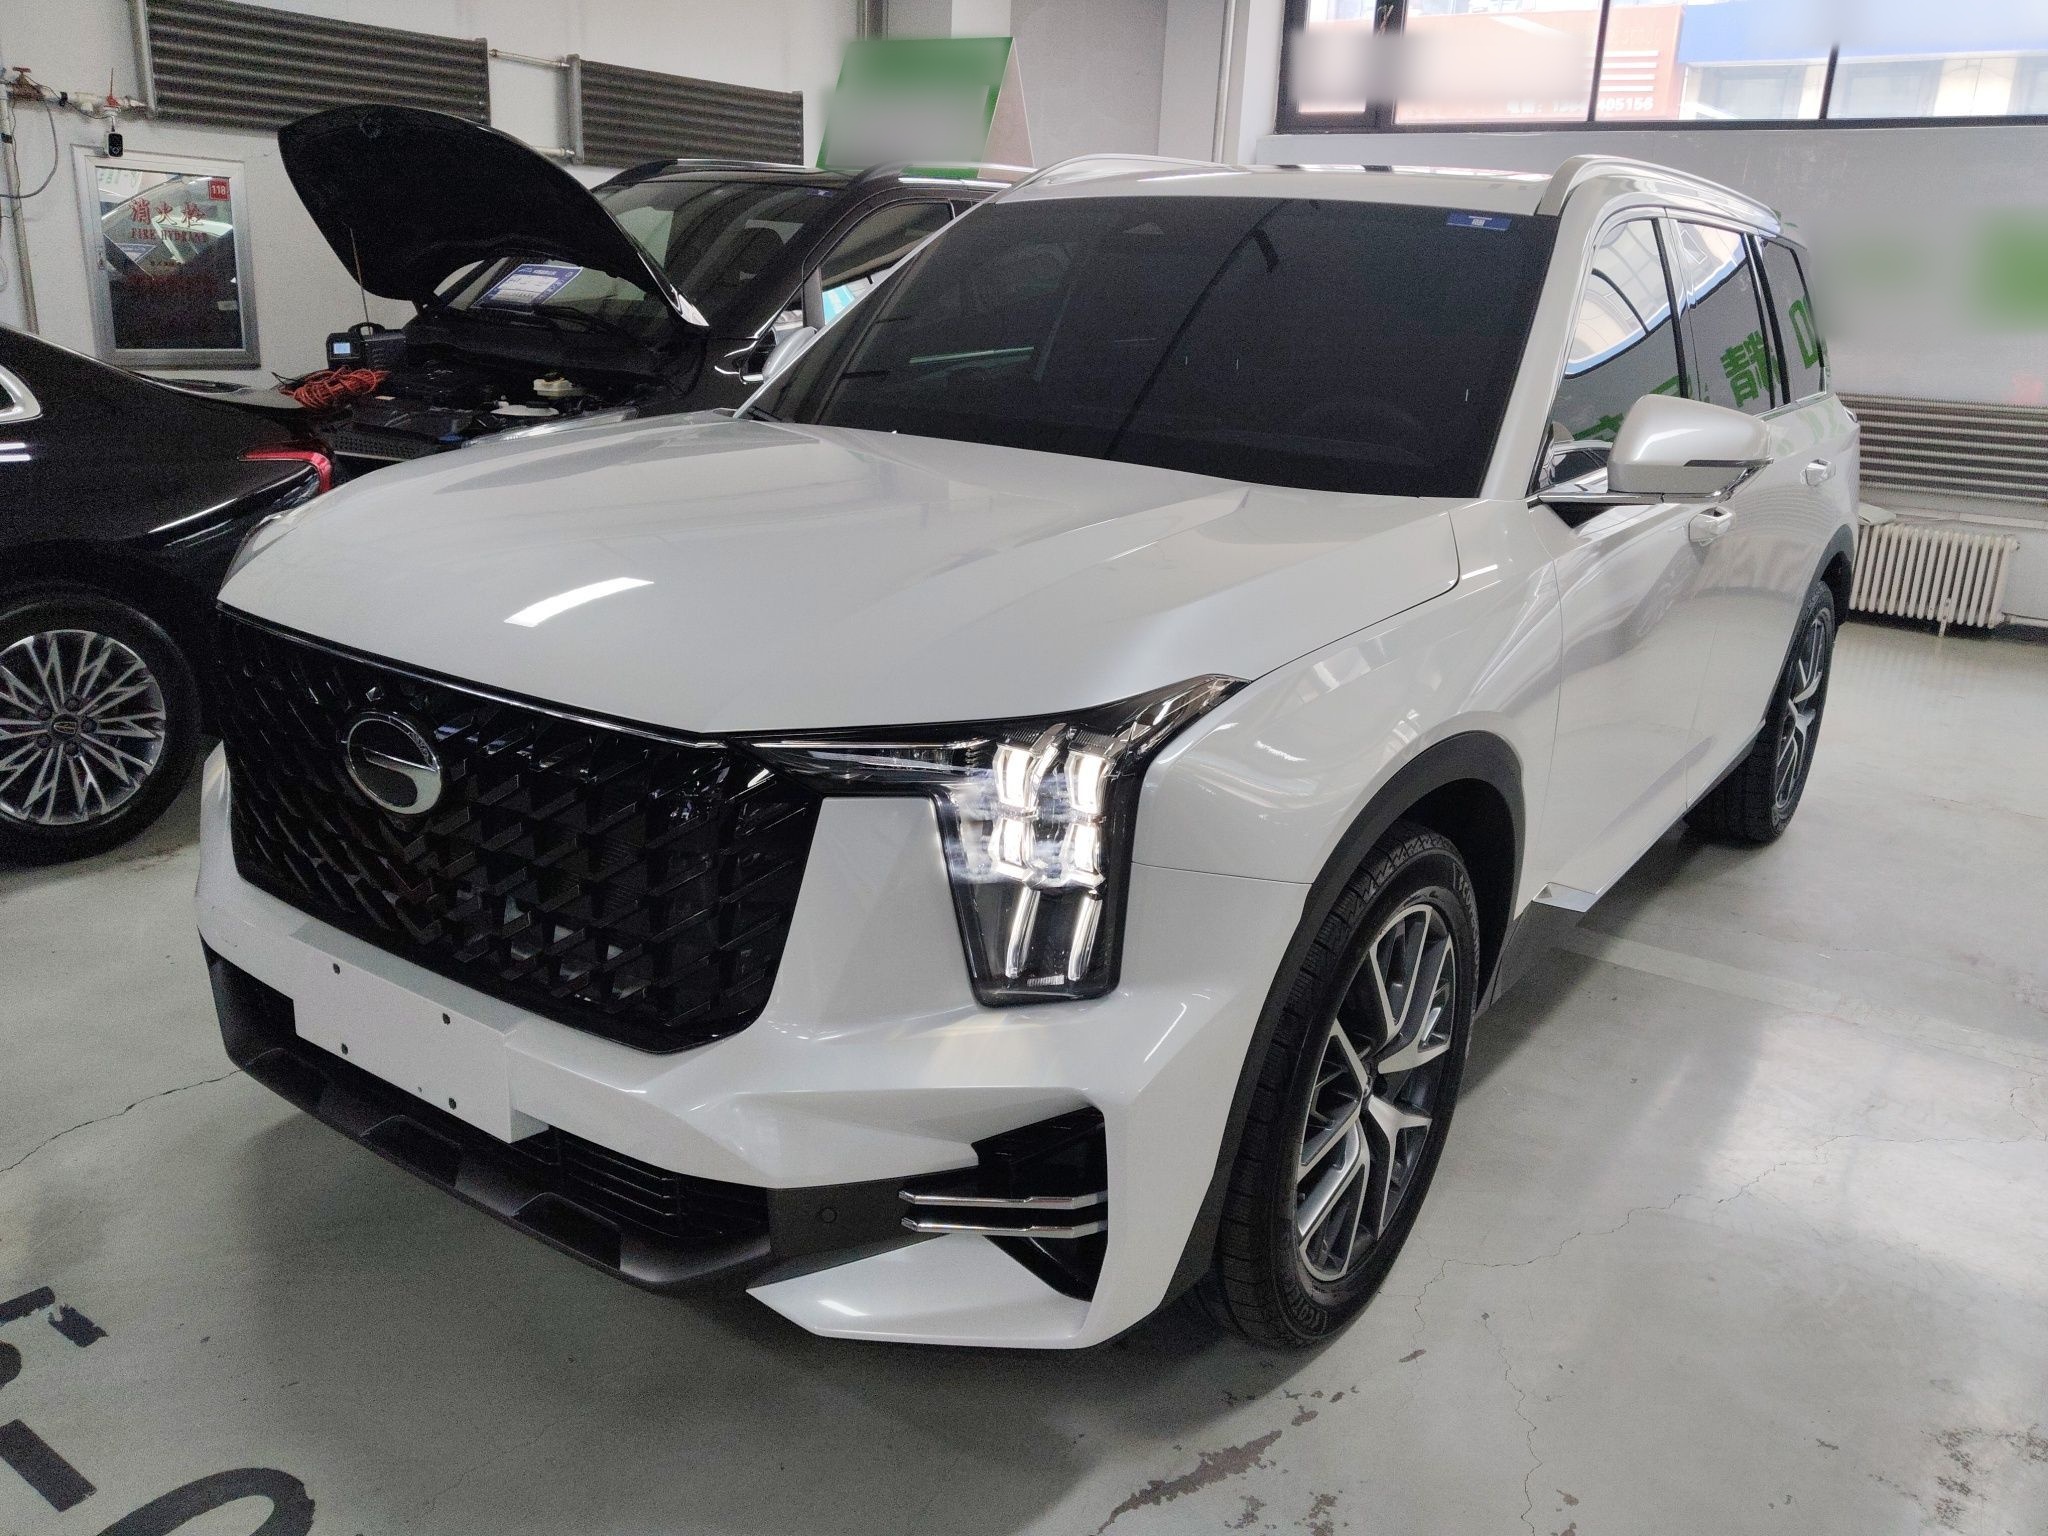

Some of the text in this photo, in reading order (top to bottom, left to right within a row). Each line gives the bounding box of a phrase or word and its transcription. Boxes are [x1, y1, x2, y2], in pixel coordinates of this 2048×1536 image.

[130, 198, 206, 228] 消火栓
[131, 227, 206, 242] FIRE HYDRANT
